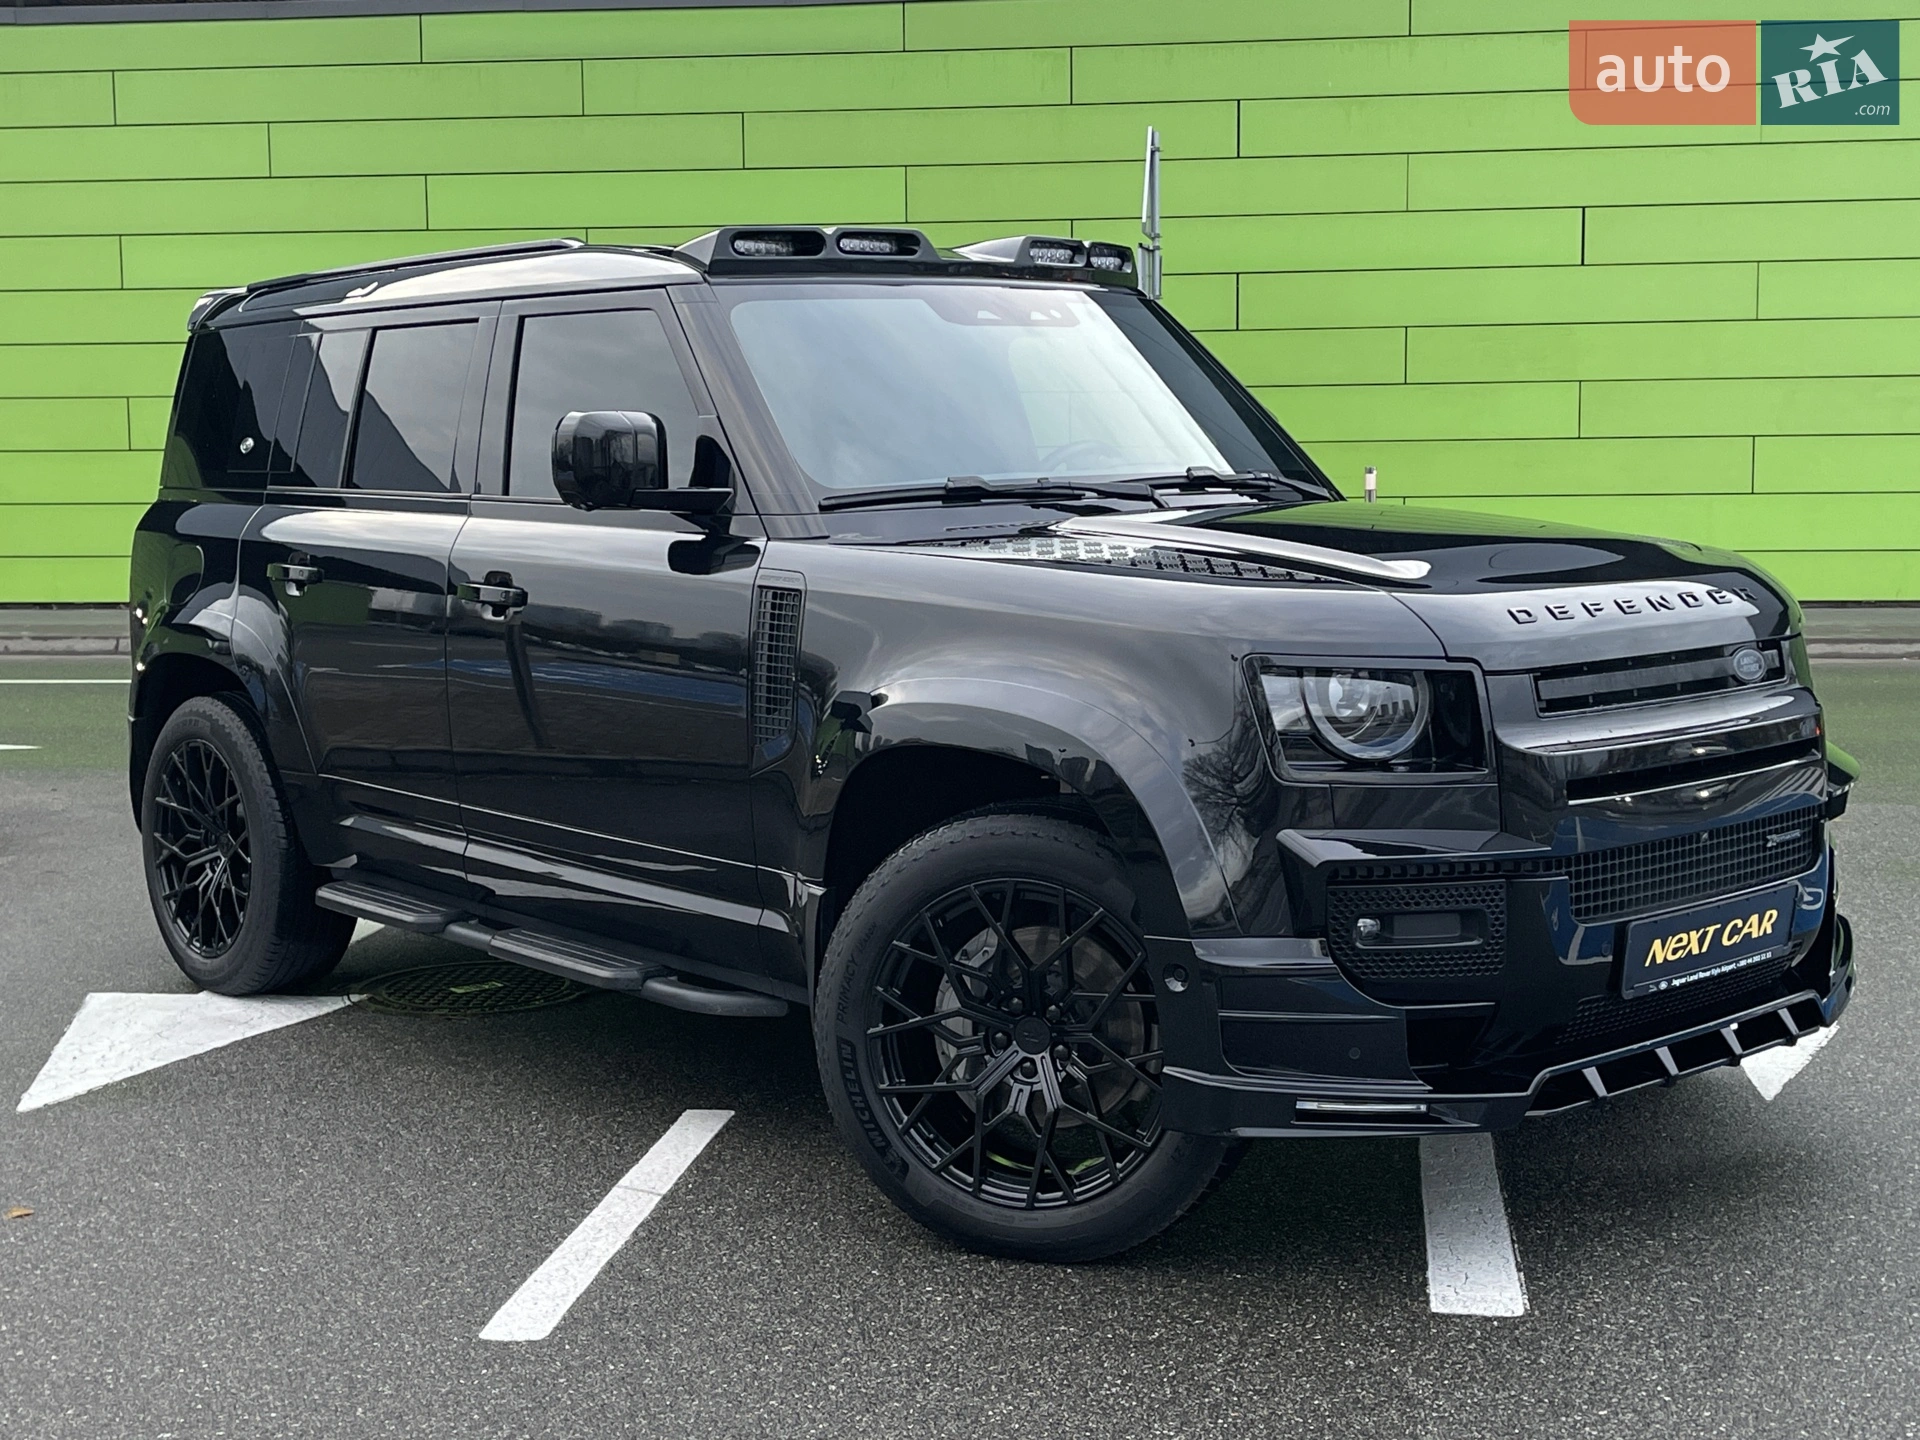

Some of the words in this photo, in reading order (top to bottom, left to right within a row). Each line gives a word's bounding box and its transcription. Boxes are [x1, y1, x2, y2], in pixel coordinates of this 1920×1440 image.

[1507, 587, 1758, 624] DEFENDER
[1721, 909, 1778, 946] CAR
[837, 953, 860, 1025] PRIMACY
[840, 1042, 886, 1148] MICHELIN
